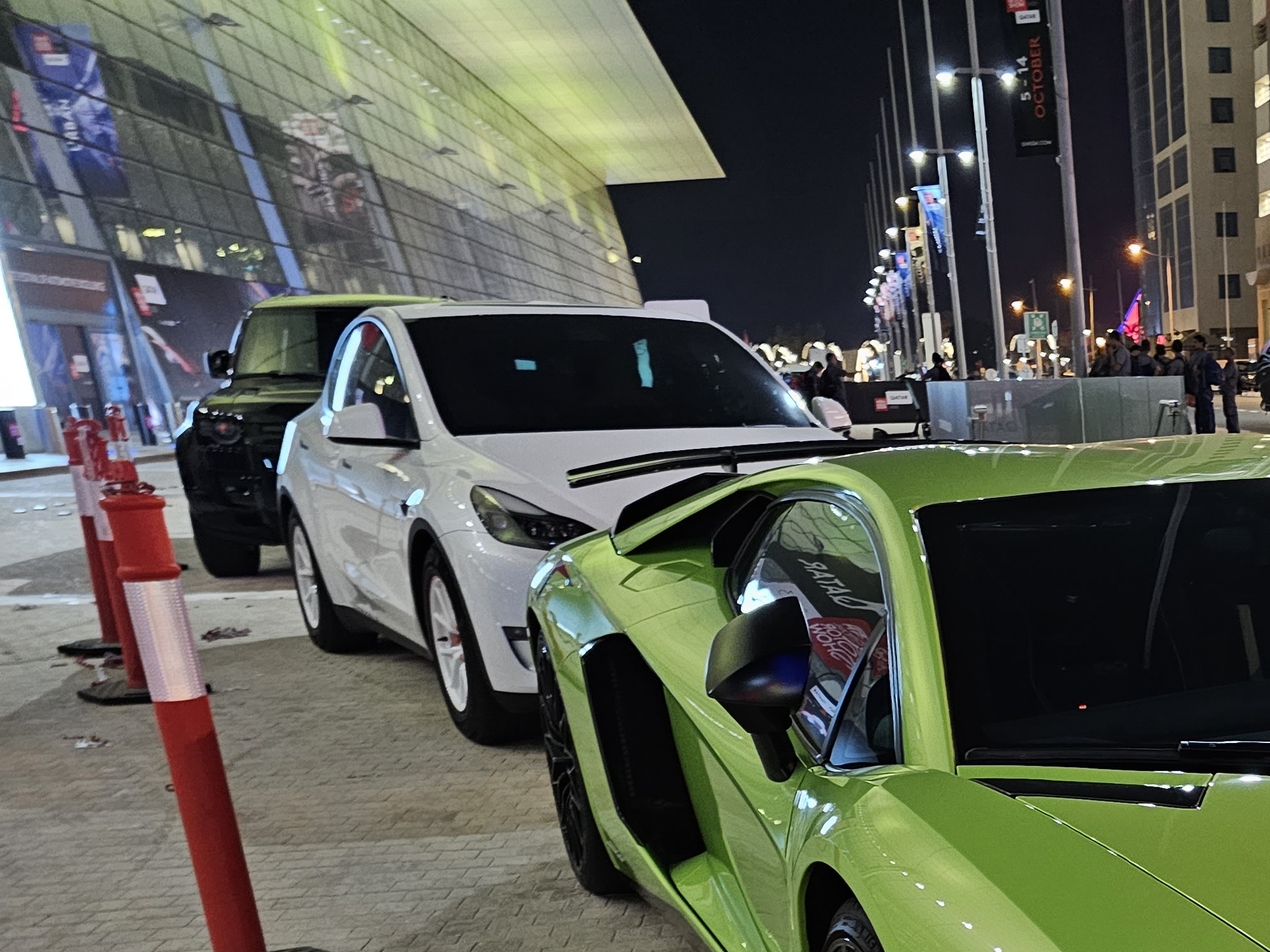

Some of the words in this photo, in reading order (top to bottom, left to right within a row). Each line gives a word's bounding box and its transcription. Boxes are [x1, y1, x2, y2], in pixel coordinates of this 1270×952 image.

[1016, 56, 1029, 75] 14
[1028, 36, 1046, 118] OCTOBER
[1020, 91, 1032, 101] 5
